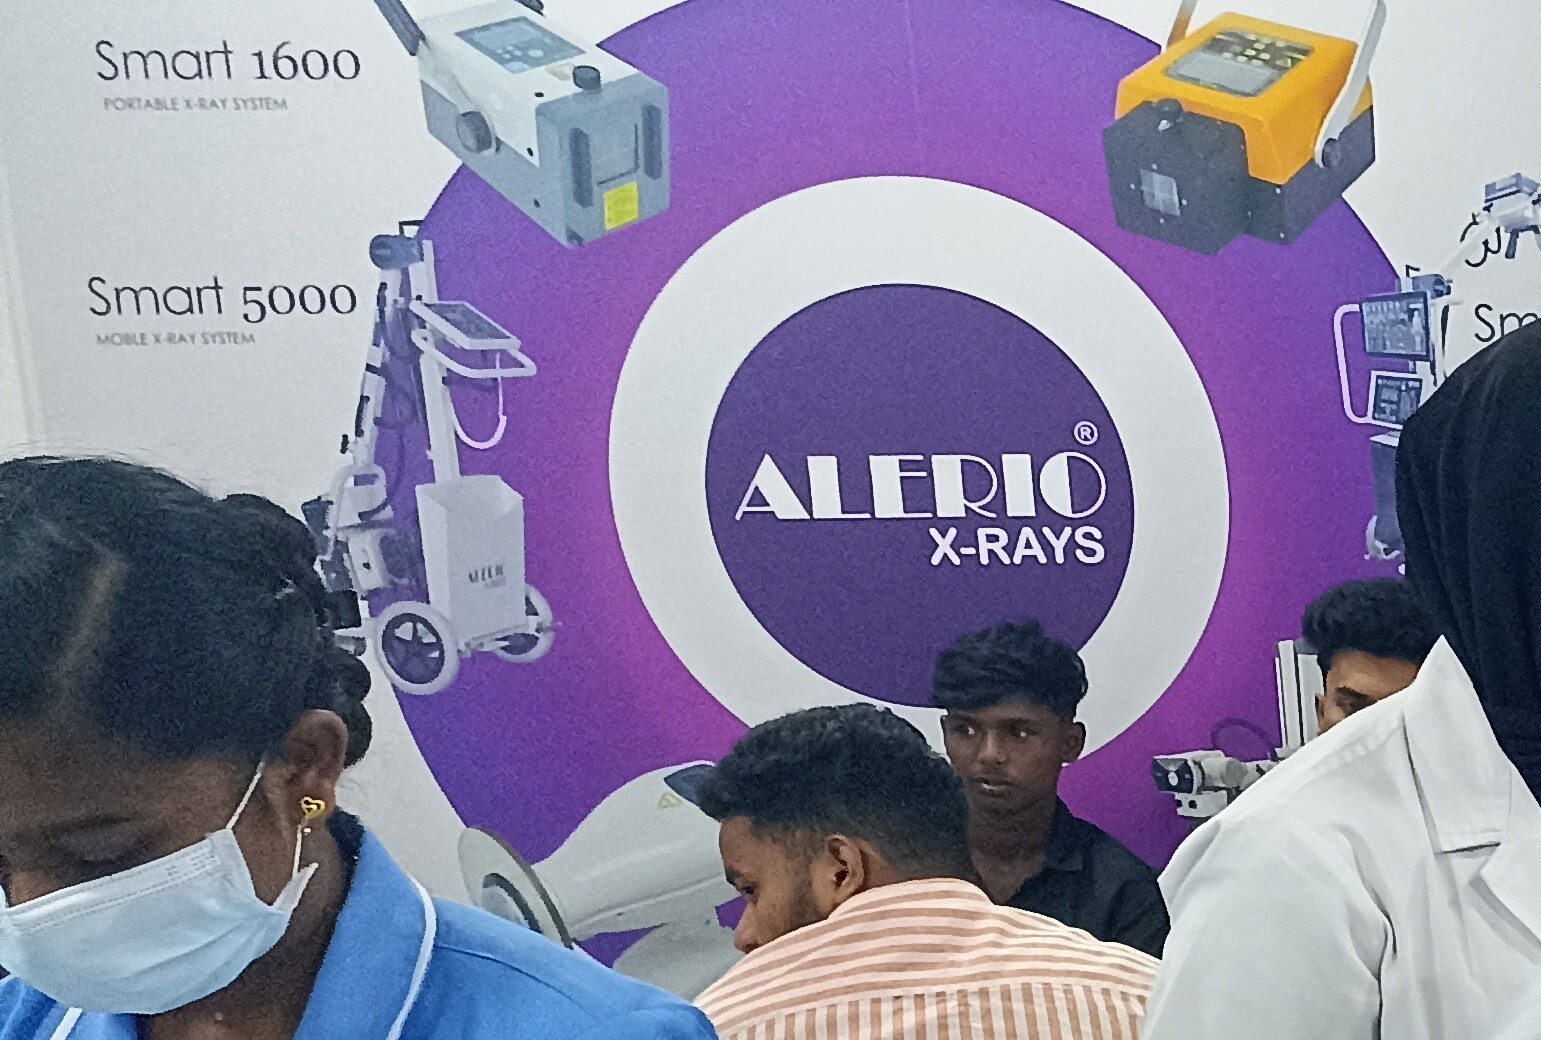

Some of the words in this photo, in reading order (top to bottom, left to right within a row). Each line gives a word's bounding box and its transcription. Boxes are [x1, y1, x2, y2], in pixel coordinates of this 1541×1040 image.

[95, 40, 234, 81] Smart
[251, 40, 361, 81] 1600
[232, 96, 288, 111] SYSTEM
[88, 276, 223, 316] Smart
[243, 284, 357, 324] 5000
[201, 331, 256, 346] SYSTEM
[735, 451, 1107, 521] ALERIO
[929, 525, 1105, 565] X-RAYS
